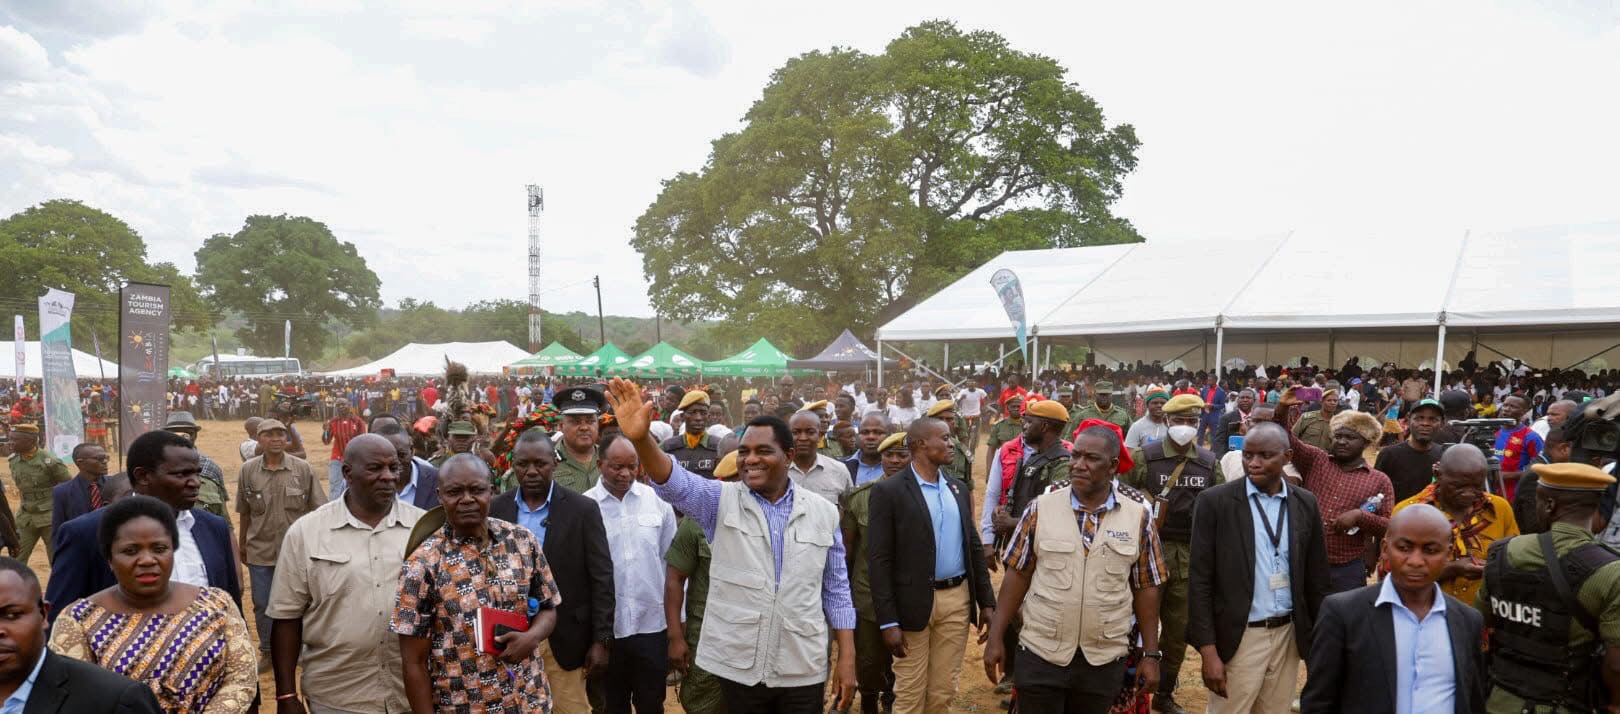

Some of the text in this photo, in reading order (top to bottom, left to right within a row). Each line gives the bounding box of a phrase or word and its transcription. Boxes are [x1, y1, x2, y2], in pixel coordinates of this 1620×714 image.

[130, 293, 161, 303] ZAMBIA
[128, 300, 163, 310] TOURISM
[129, 307, 162, 316] AGENCY
[1159, 474, 1205, 487] PLICE
[1489, 596, 1542, 627] POLICE
